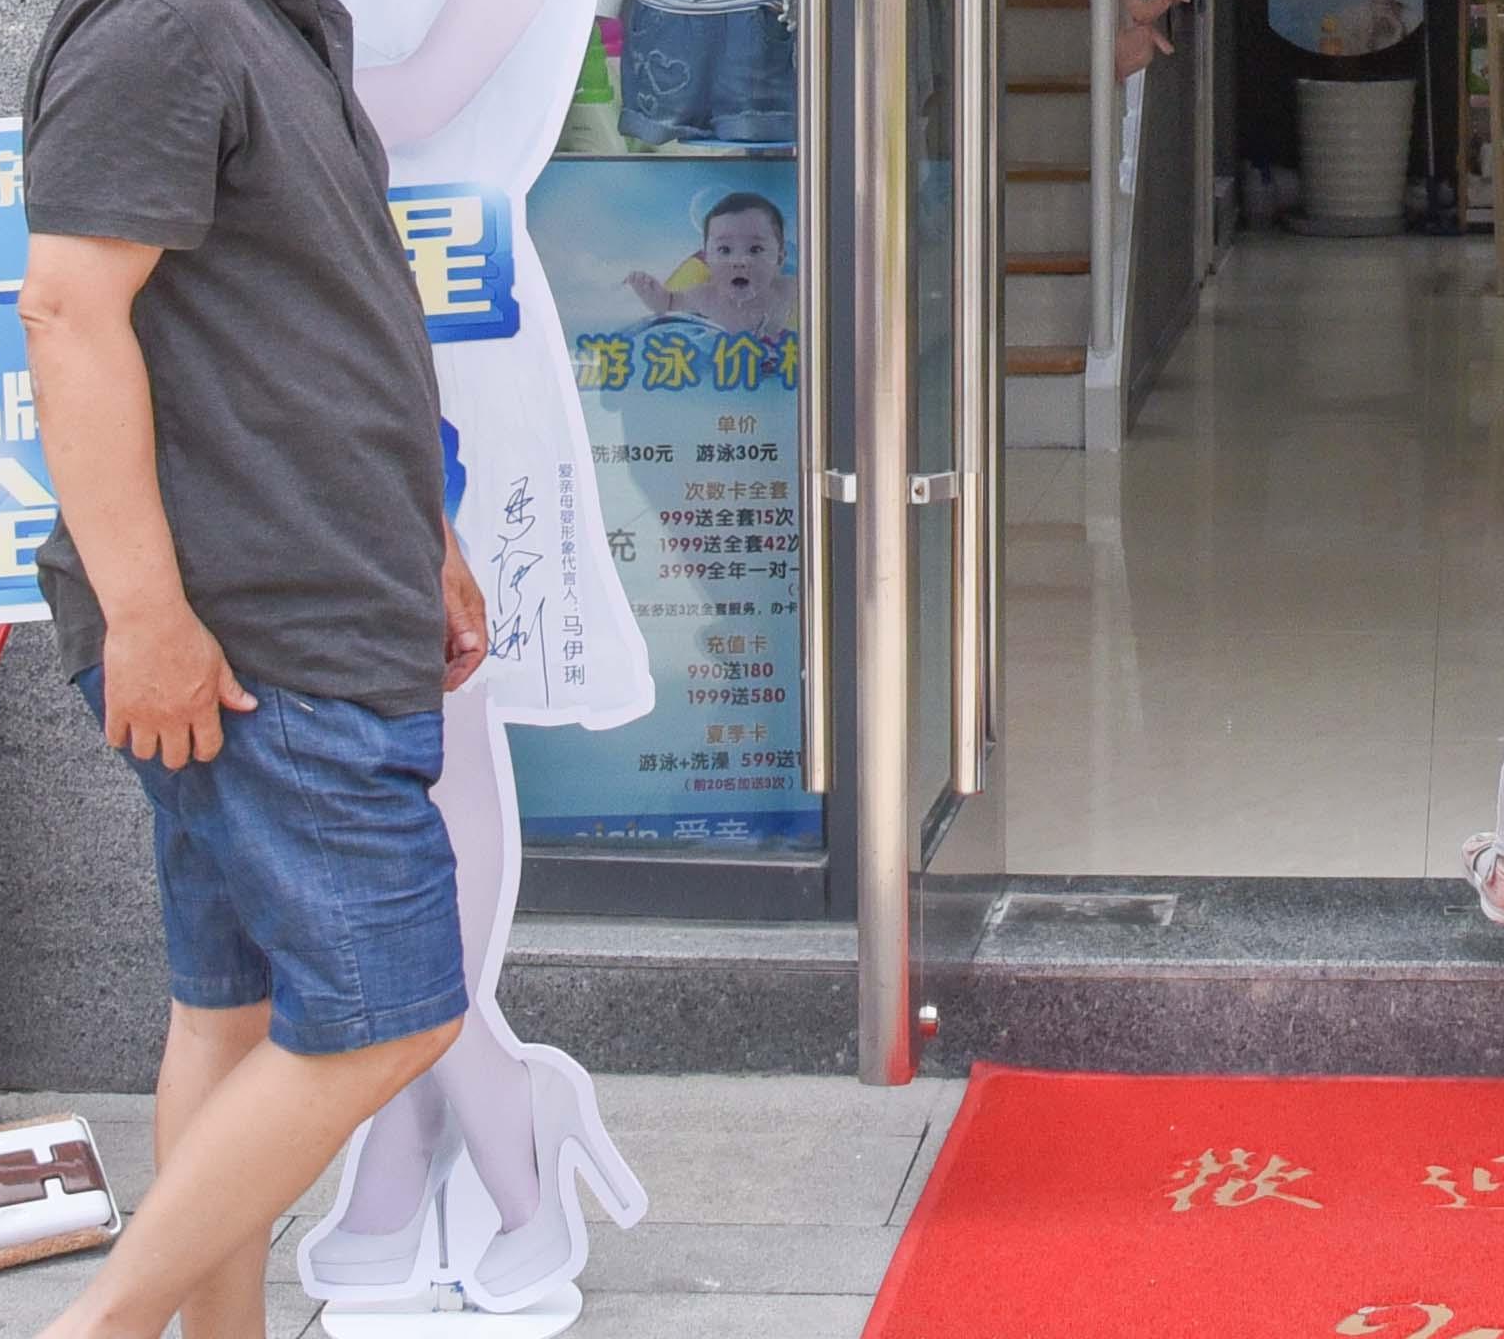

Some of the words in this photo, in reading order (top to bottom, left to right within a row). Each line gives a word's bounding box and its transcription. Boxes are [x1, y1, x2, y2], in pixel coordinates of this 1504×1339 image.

[717, 415, 758, 435] 单价
[696, 443, 778, 464] 游泳30元
[685, 481, 791, 501] 次数卡全套
[660, 508, 794, 527] 999送全套15次
[707, 635, 769, 654] 充值卡
[687, 662, 774, 681] 990送180
[687, 687, 786, 706] 1999送580
[705, 723, 769, 744] 夏季卡
[639, 752, 730, 772] 游泳+洗澡
